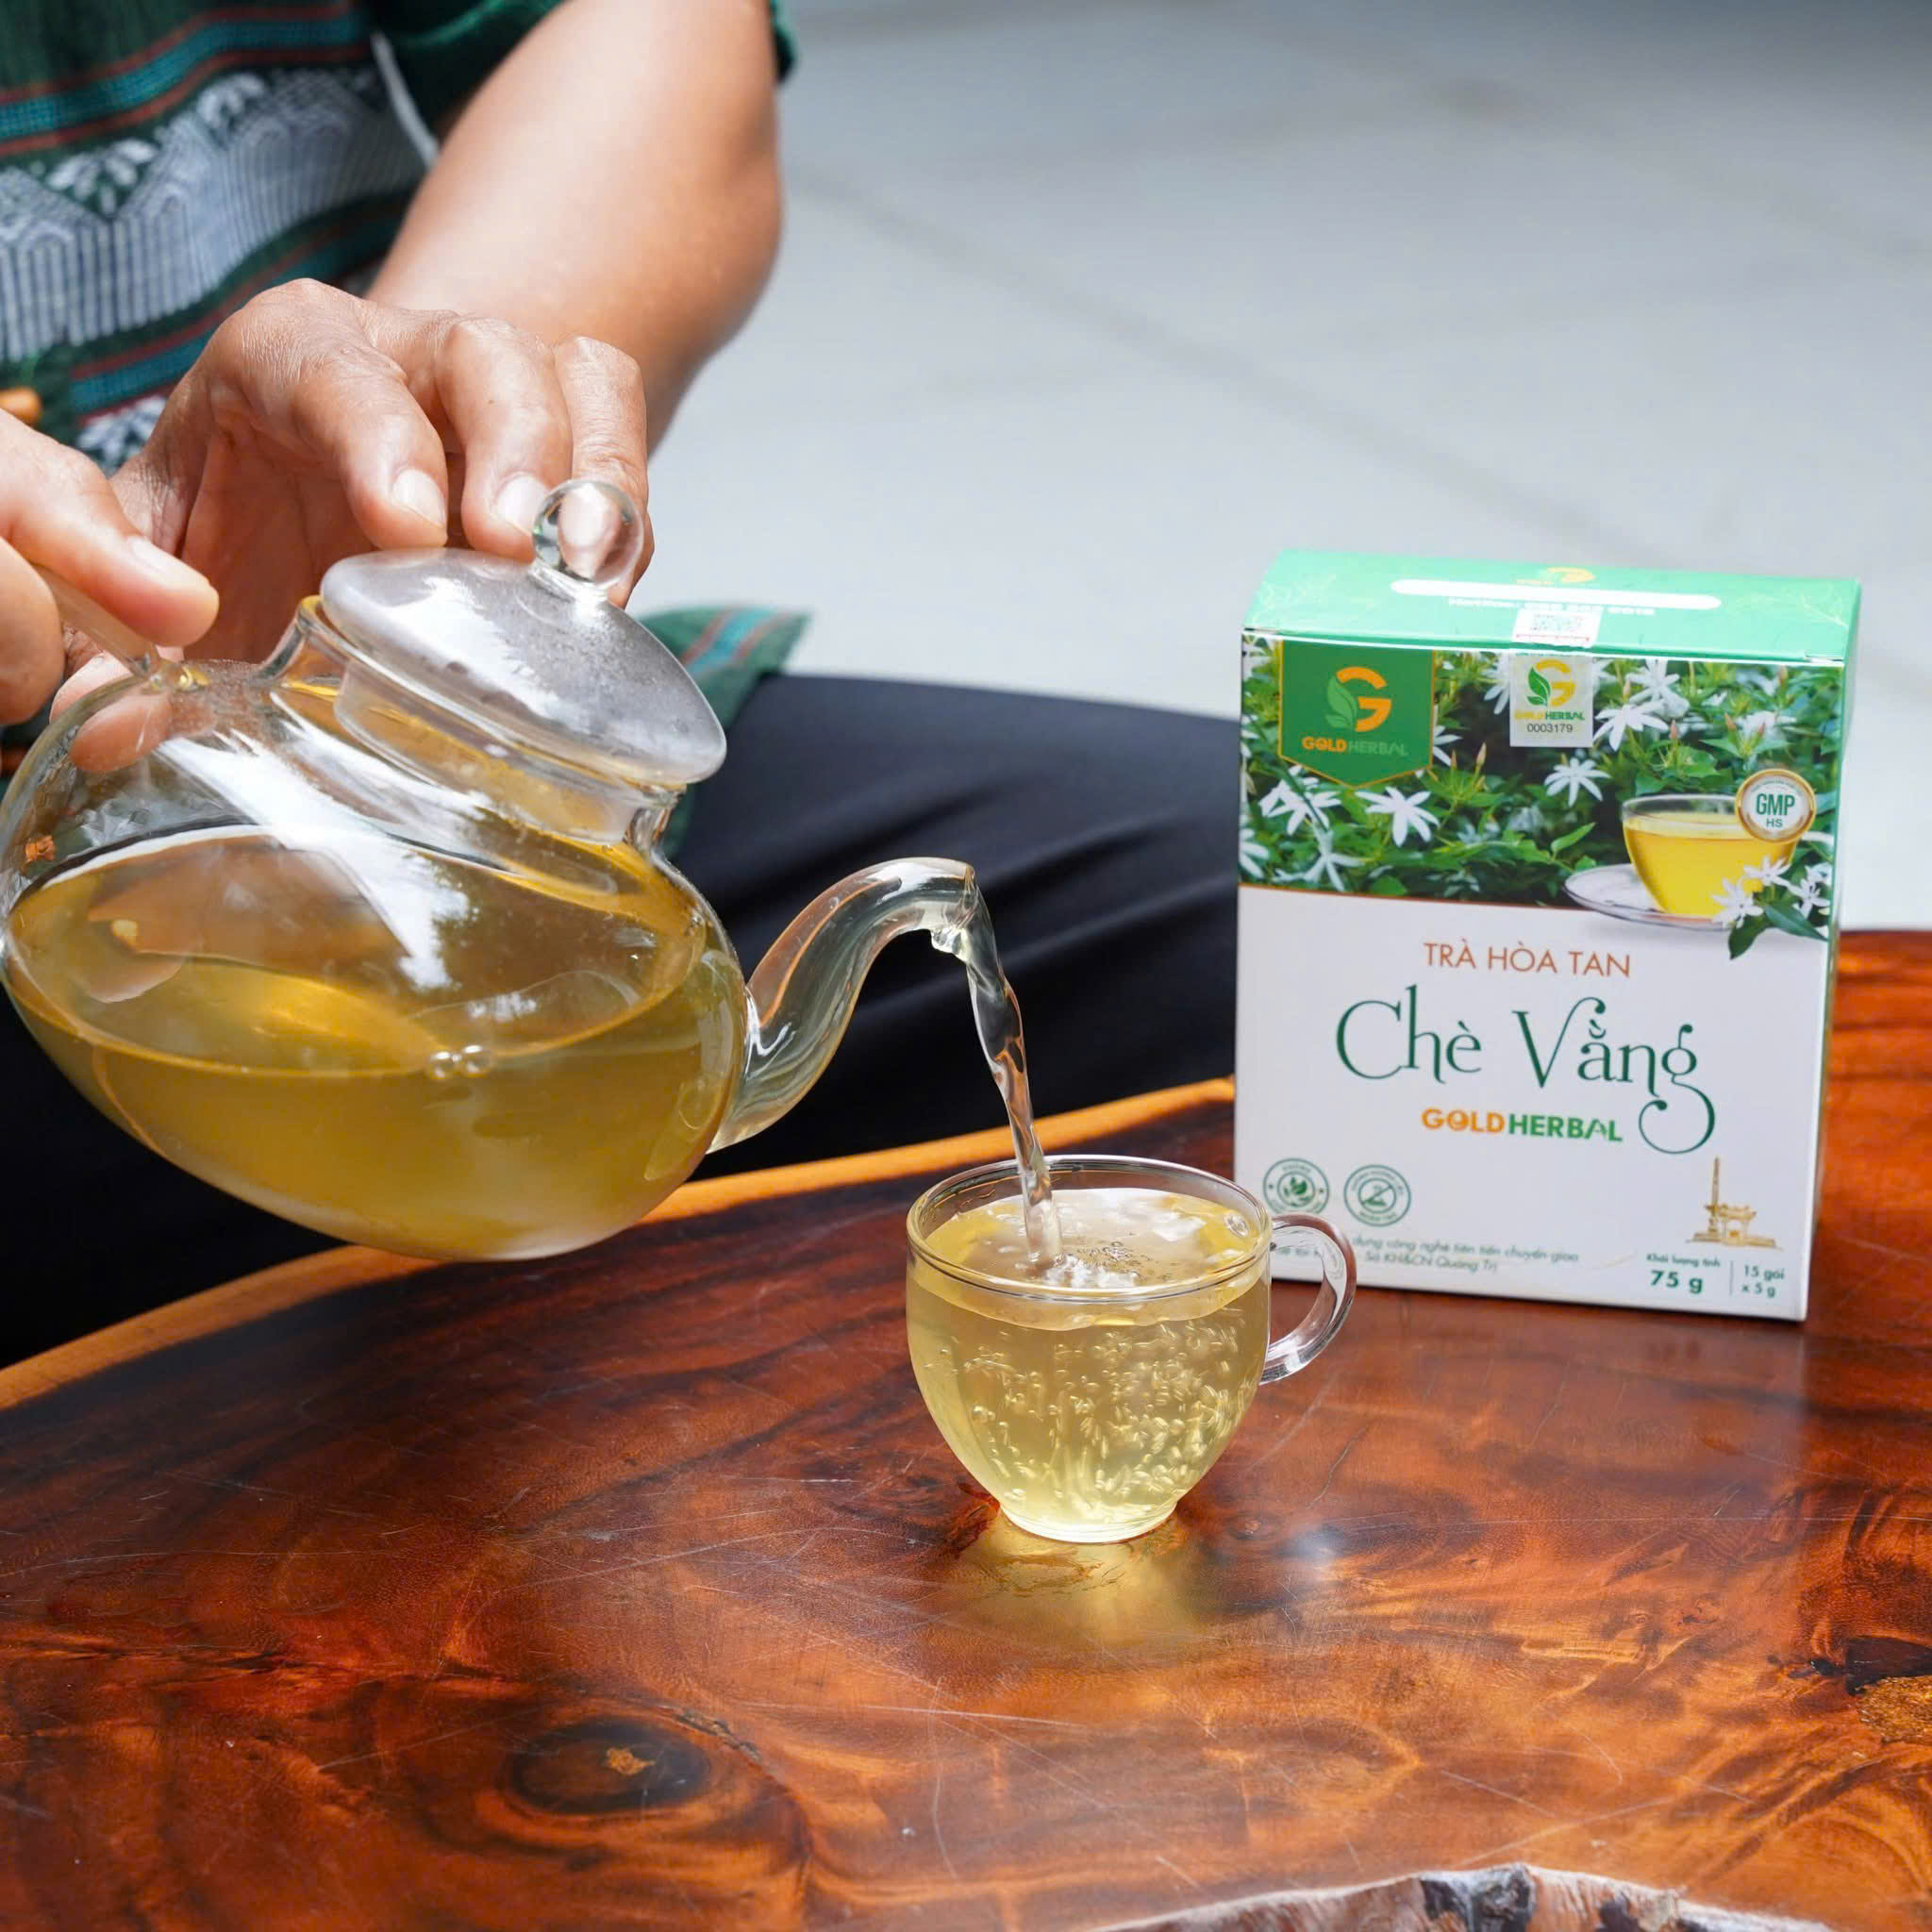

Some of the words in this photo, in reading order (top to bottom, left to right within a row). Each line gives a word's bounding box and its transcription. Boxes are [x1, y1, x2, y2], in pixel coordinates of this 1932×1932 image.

[1526, 723, 1574, 733] 0003179
[1756, 793, 1795, 816] GMP
[1766, 818, 1783, 827] HS
[1424, 939, 1476, 970] TRÀ
[1488, 941, 1558, 974] HÒA
[1569, 951, 1632, 977] TAN
[1336, 984, 1482, 1084] Chè
[1511, 996, 1716, 1155] Vằng
[1744, 1265, 1759, 1277] 15
[1650, 1270, 1680, 1289] 75
[1689, 1277, 1704, 1294] g
[1755, 1282, 1763, 1294] 5
[1767, 1286, 1776, 1299] g
